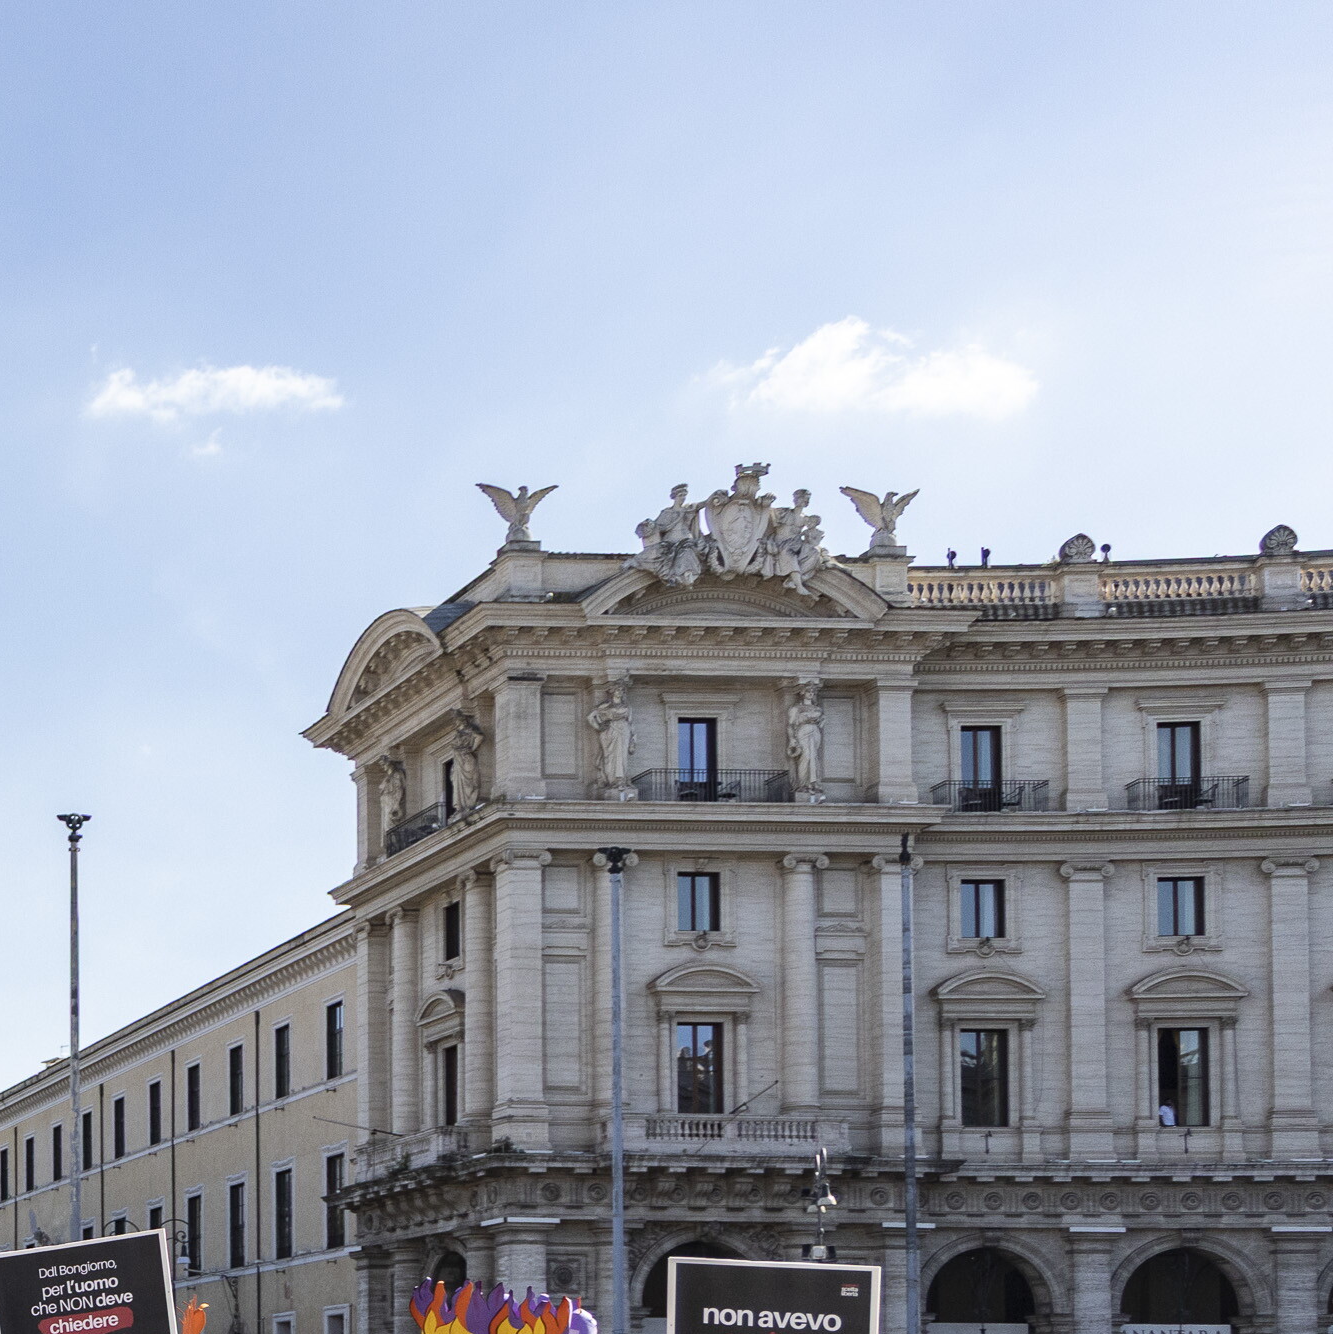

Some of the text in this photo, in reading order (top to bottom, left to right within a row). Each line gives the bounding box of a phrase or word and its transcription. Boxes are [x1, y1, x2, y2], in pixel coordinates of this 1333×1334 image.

[38, 1259, 117, 1279] Ddl Bongiorno,
[42, 1276, 119, 1300] per l'uomo
[30, 1292, 133, 1316] che NON deve
[49, 1314, 119, 1334] chiedere
[702, 1307, 842, 1332] non avevo
